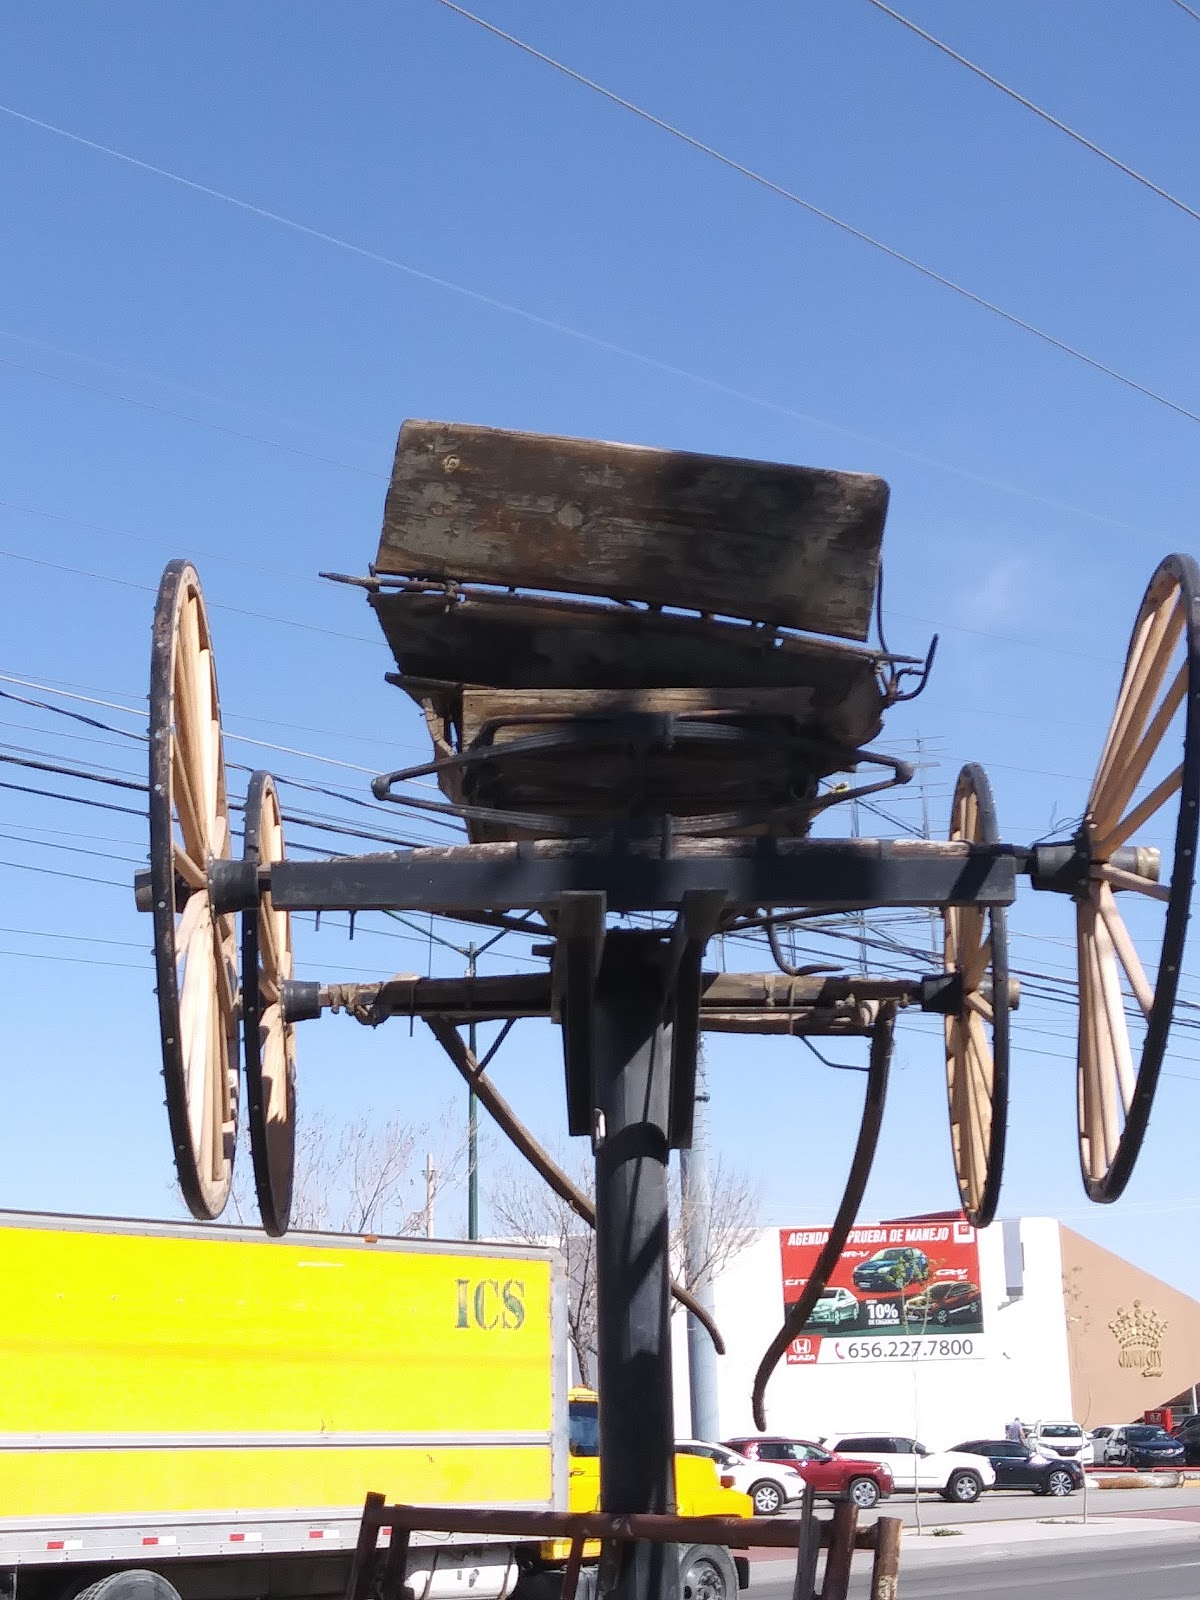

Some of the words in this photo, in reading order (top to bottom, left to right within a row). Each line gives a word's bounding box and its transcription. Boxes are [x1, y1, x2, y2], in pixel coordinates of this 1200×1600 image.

[788, 1232, 829, 1246] AGENDA
[846, 1230, 887, 1244] PRUEBA
[889, 1229, 904, 1242] DE
[905, 1227, 949, 1241] MANEJO
[455, 1278, 525, 1330] ICS
[867, 1303, 898, 1319] 10%
[788, 1354, 816, 1362] PLAZA
[848, 1339, 973, 1358] 656.227.7800
